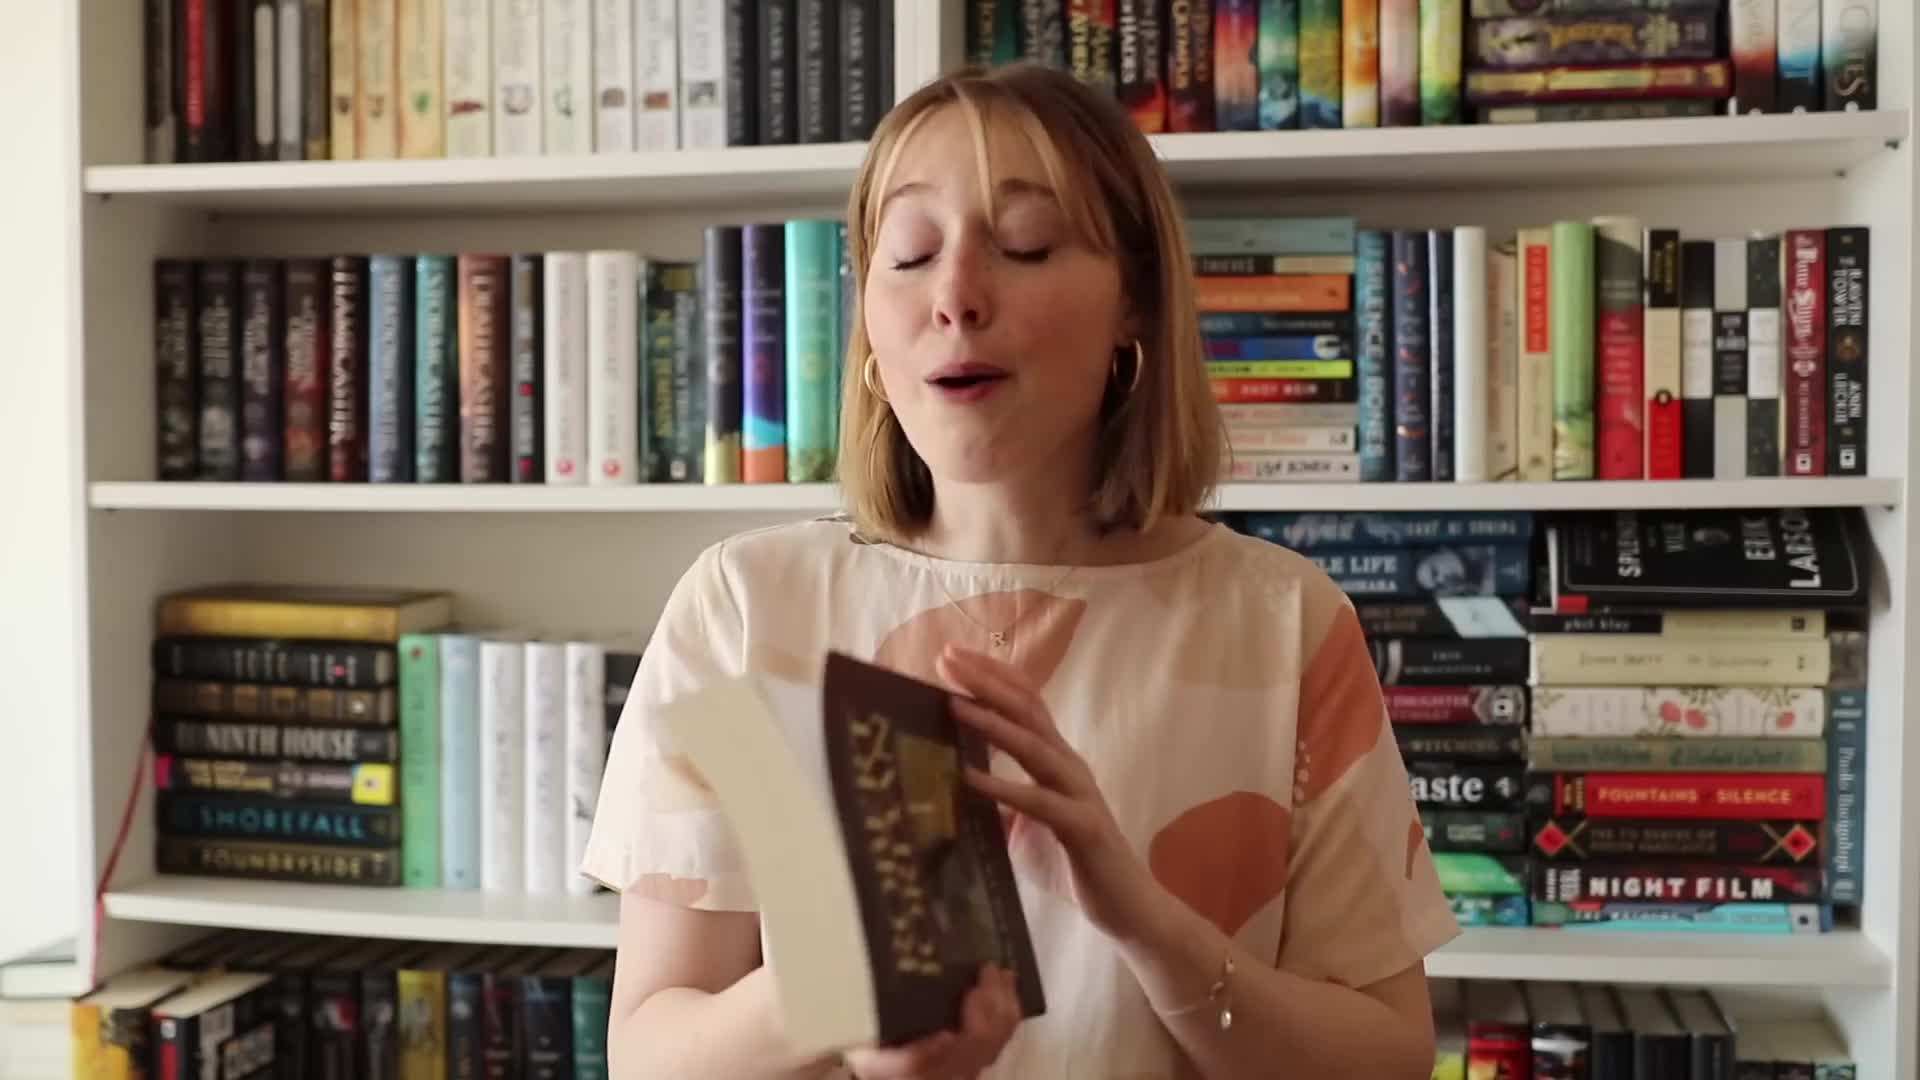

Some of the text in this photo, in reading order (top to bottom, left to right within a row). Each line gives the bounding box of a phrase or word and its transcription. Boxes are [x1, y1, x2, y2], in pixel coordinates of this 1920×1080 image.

[1832, 268, 1848, 328] TOWER
[1364, 261, 1385, 458] SILENCE BONES
[1776, 508, 1822, 589] LARSO
[1350, 556, 1398, 575] LIFE
[206, 725, 356, 760] NINTH HOUSE
[1409, 773, 1485, 802] aste
[1597, 788, 1698, 803] FOUNTAINS
[1716, 789, 1792, 804] SILENCE
[202, 806, 366, 839] SHOREFALL
[1588, 877, 1686, 898] NIGHT
[1695, 877, 1775, 899] FILM
